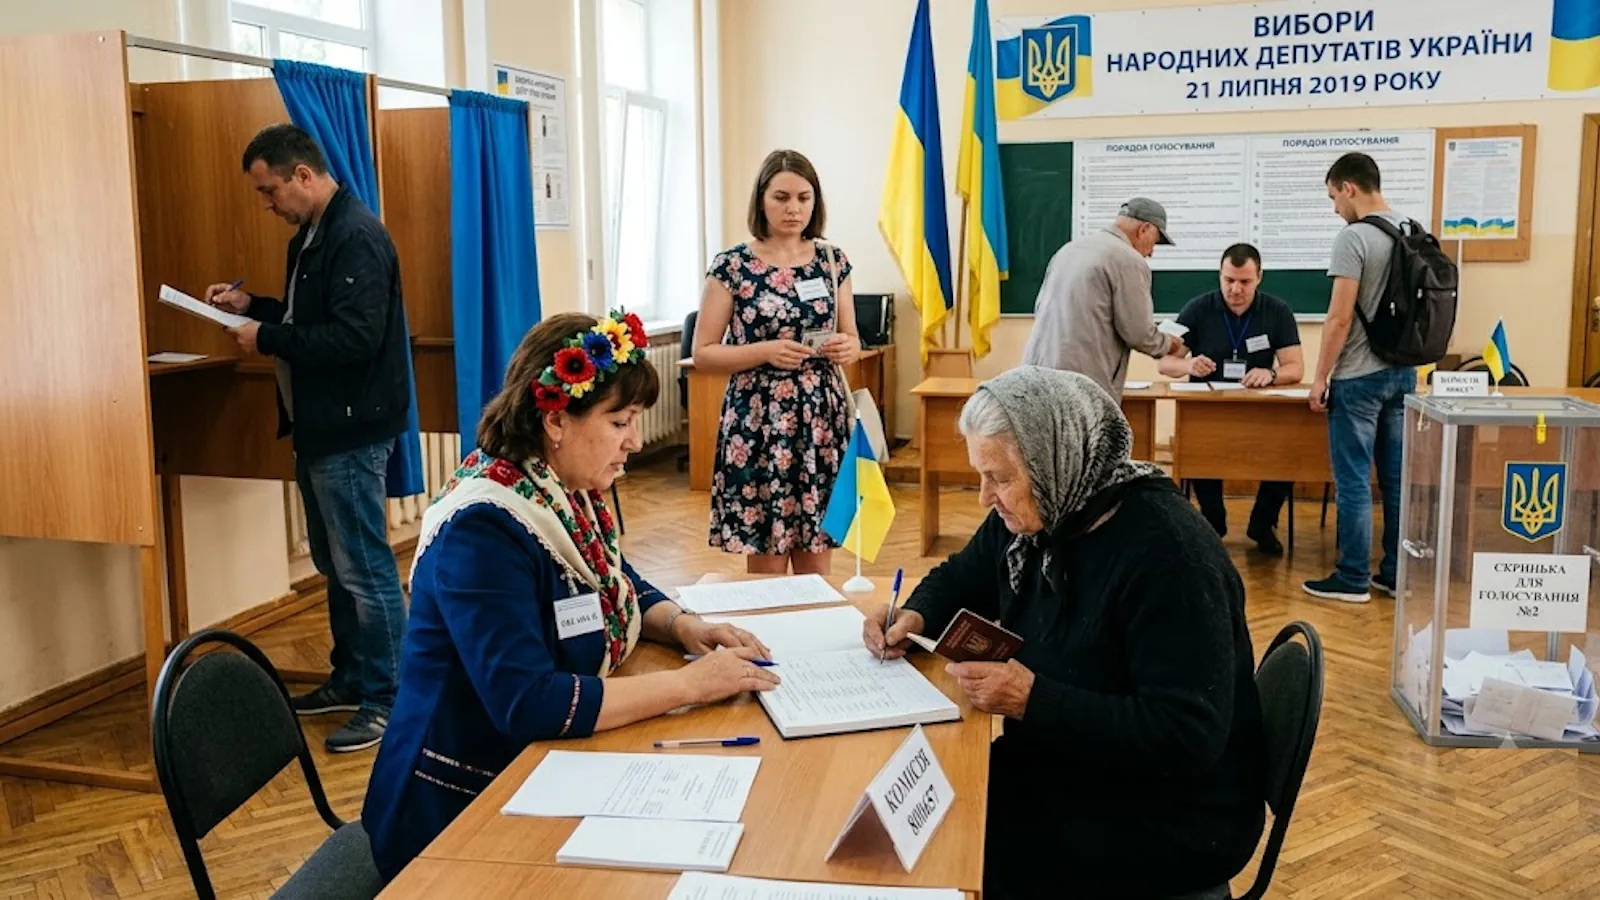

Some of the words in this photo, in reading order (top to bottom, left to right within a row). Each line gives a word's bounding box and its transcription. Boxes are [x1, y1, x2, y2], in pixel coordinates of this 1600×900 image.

[1254, 9, 1374, 37] ВИБОРИ
[1107, 47, 1248, 74] НАРОДНИХ
[1256, 39, 1401, 70] ДЕПУТАТІВ
[1409, 29, 1532, 58] УКРАЇНИ
[1186, 82, 1210, 99] 21
[1218, 77, 1301, 98] ЛИПНЯ
[1309, 75, 1366, 94] 2019
[1374, 71, 1441, 91] РОКУ
[1494, 563, 1566, 575] СКРИНЬКА
[1515, 577, 1544, 588] ДЛЯ
[1479, 590, 1579, 603] ГОЛОСУВАННЯ
[1516, 606, 1539, 617] №2
